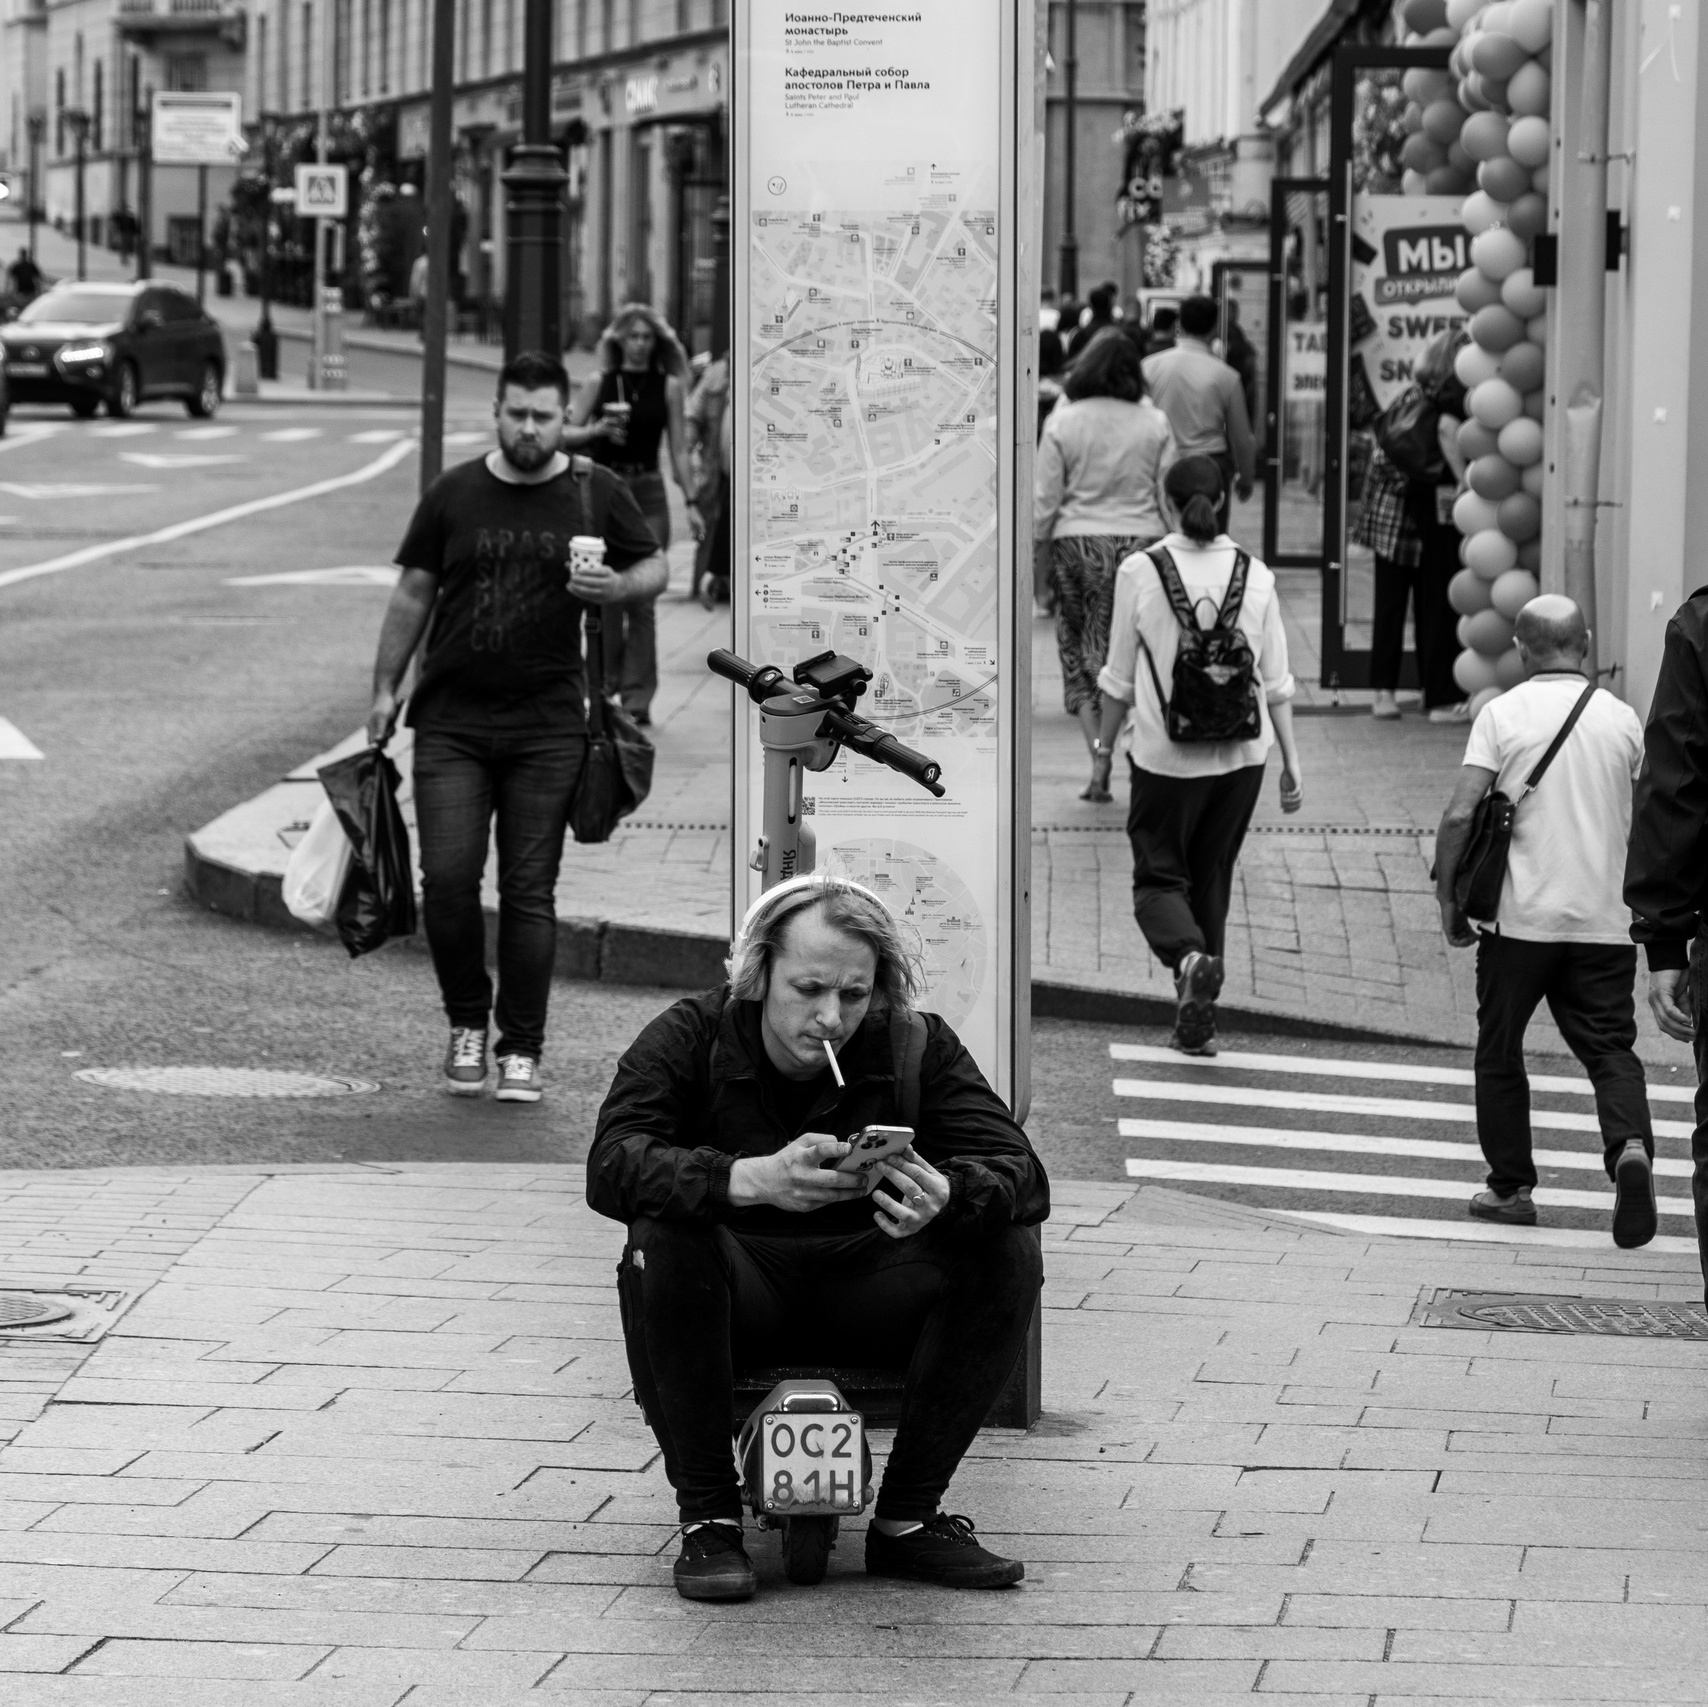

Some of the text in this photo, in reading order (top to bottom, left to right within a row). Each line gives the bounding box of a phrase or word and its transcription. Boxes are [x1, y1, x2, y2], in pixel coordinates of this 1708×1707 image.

[785, 12, 922, 24] Иоанно-Предтеченский
[785, 27, 849, 37] монастырь
[785, 38, 883, 47] St John the Baptist Convent
[785, 66, 909, 79] Кафедральный собор
[785, 79, 930, 91] апостолов Петра и Павла
[785, 93, 860, 101] Saints Peter and Paul
[785, 101, 854, 109] Lutheran Cathedral
[1397, 234, 1466, 273] МЫ
